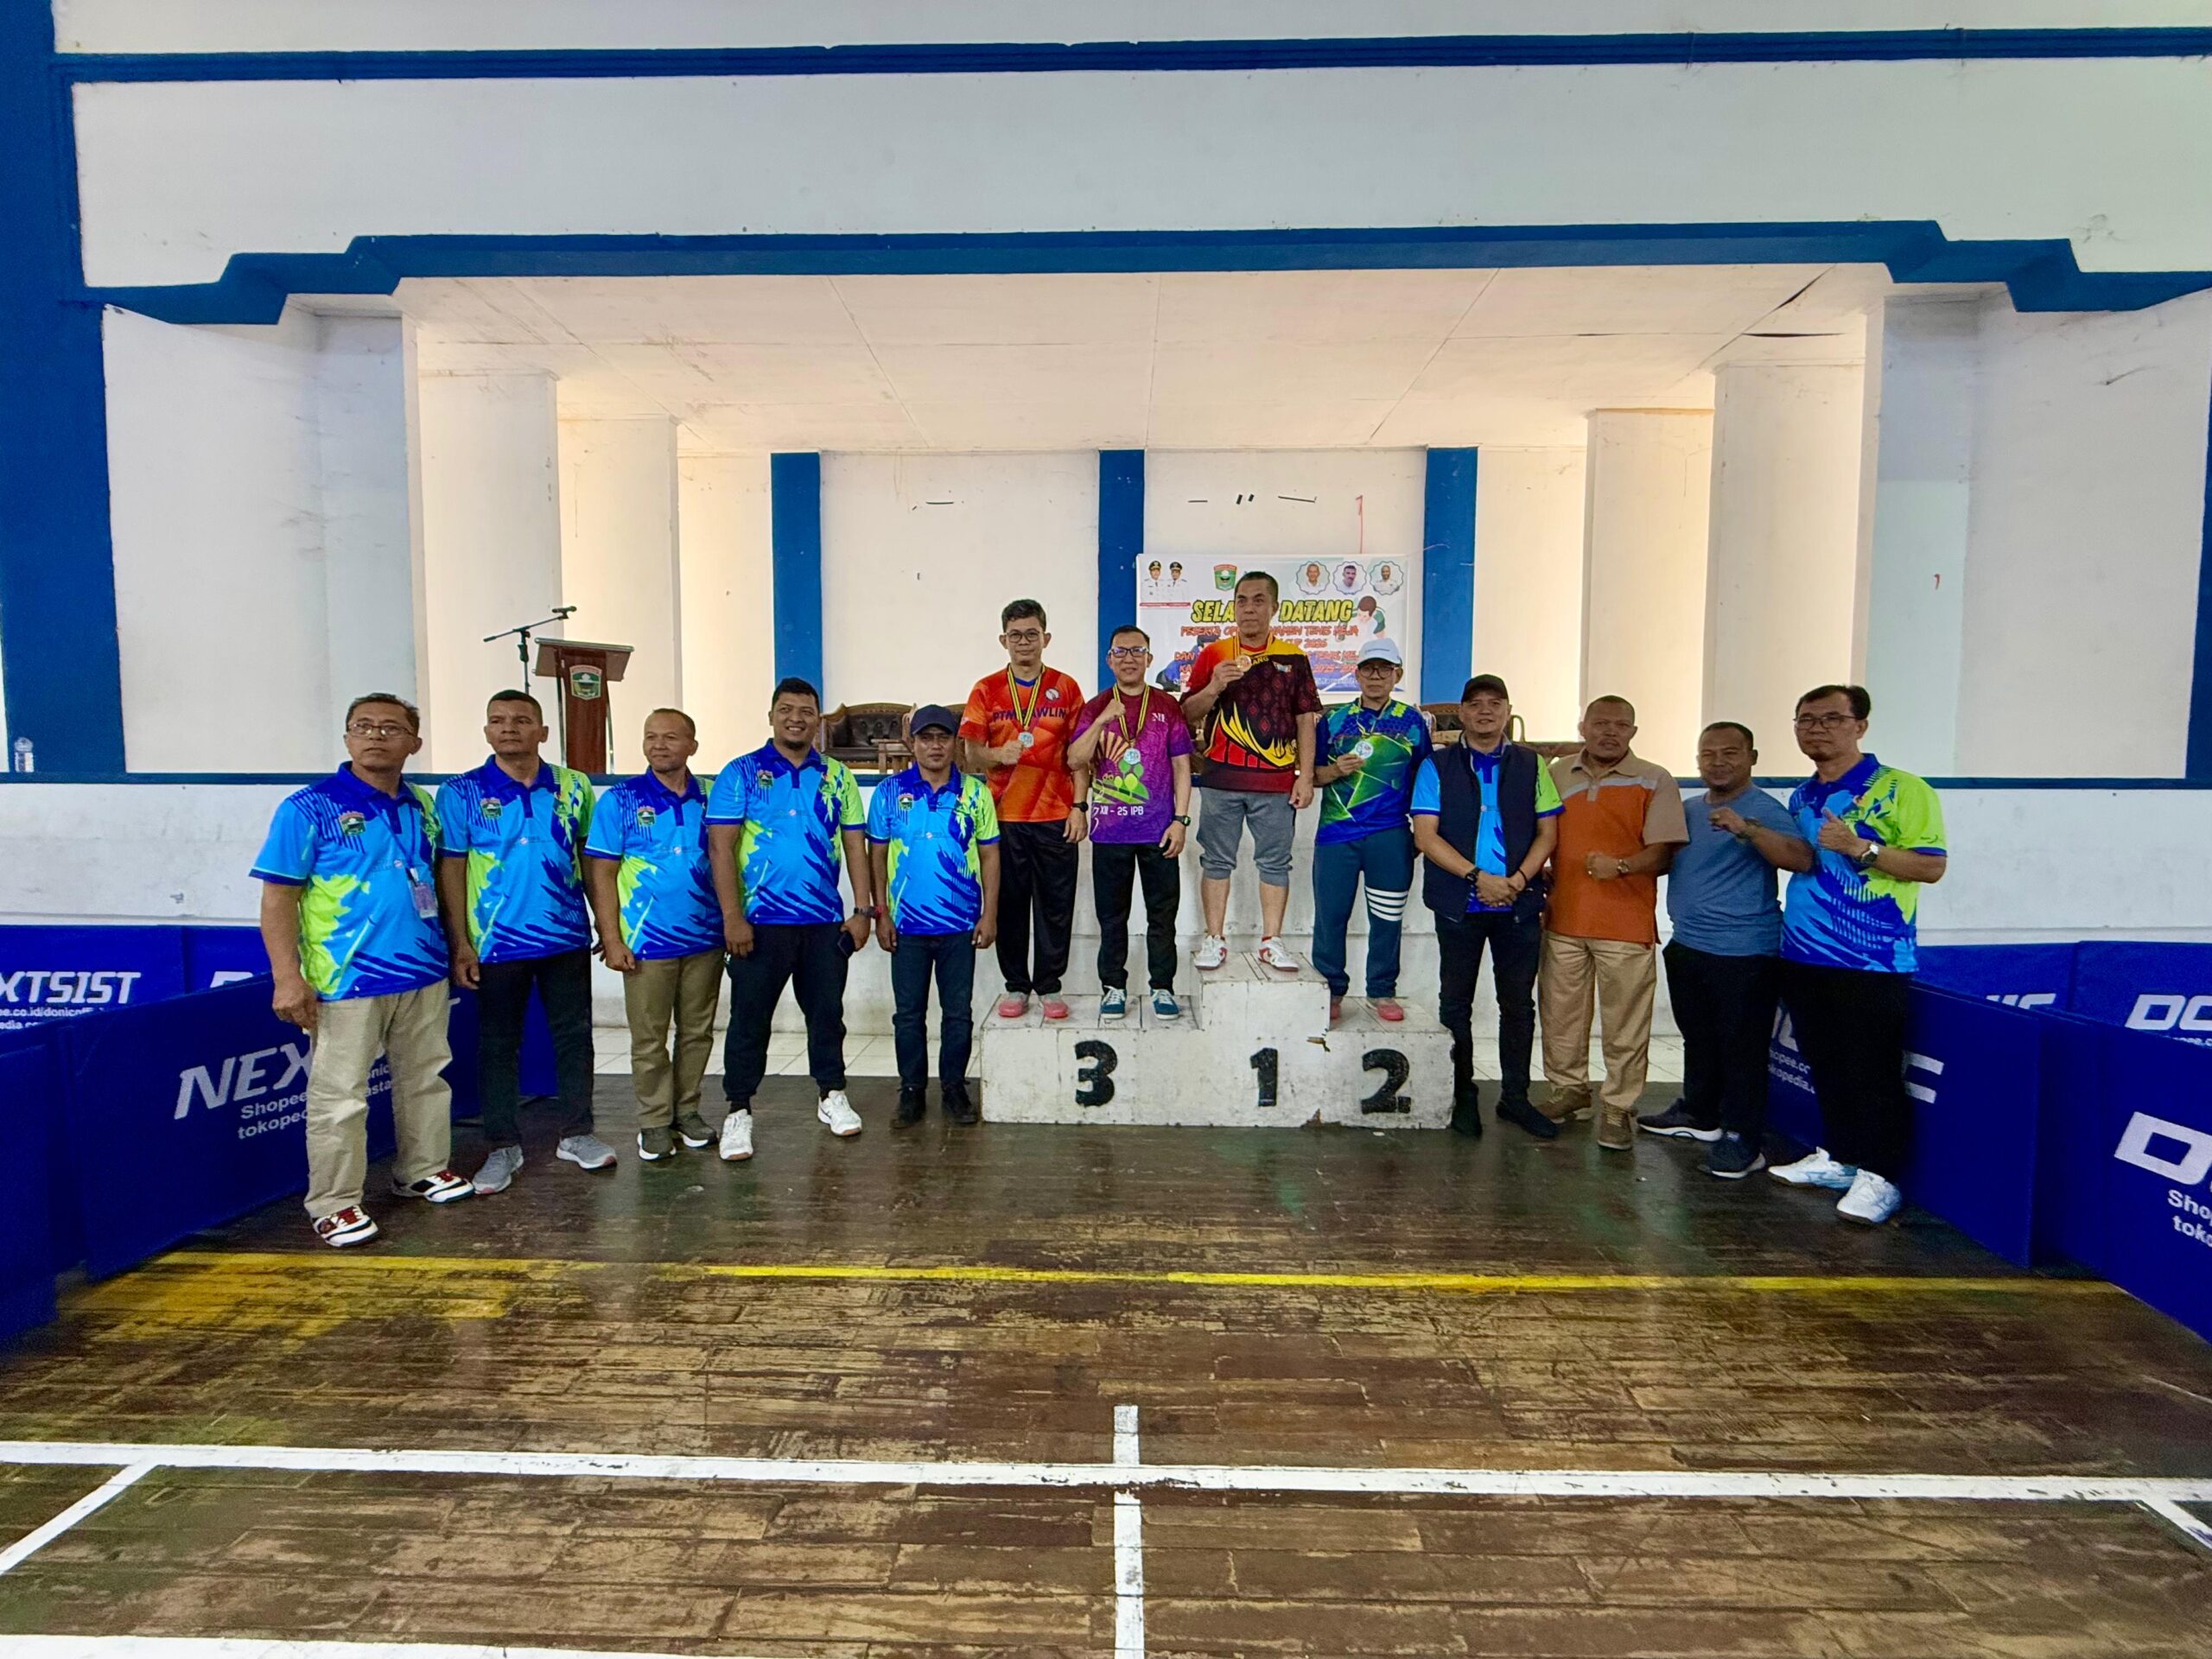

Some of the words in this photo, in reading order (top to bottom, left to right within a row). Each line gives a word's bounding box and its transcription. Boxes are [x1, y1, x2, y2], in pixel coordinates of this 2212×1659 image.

[1191, 600, 1236, 623] SELA
[1279, 599, 1354, 623] DATANG
[1117, 806, 1128, 816] 25
[1074, 1040, 1118, 1107] 3
[1250, 1047, 1279, 1107] 1
[1361, 1048, 1412, 1115] 2
